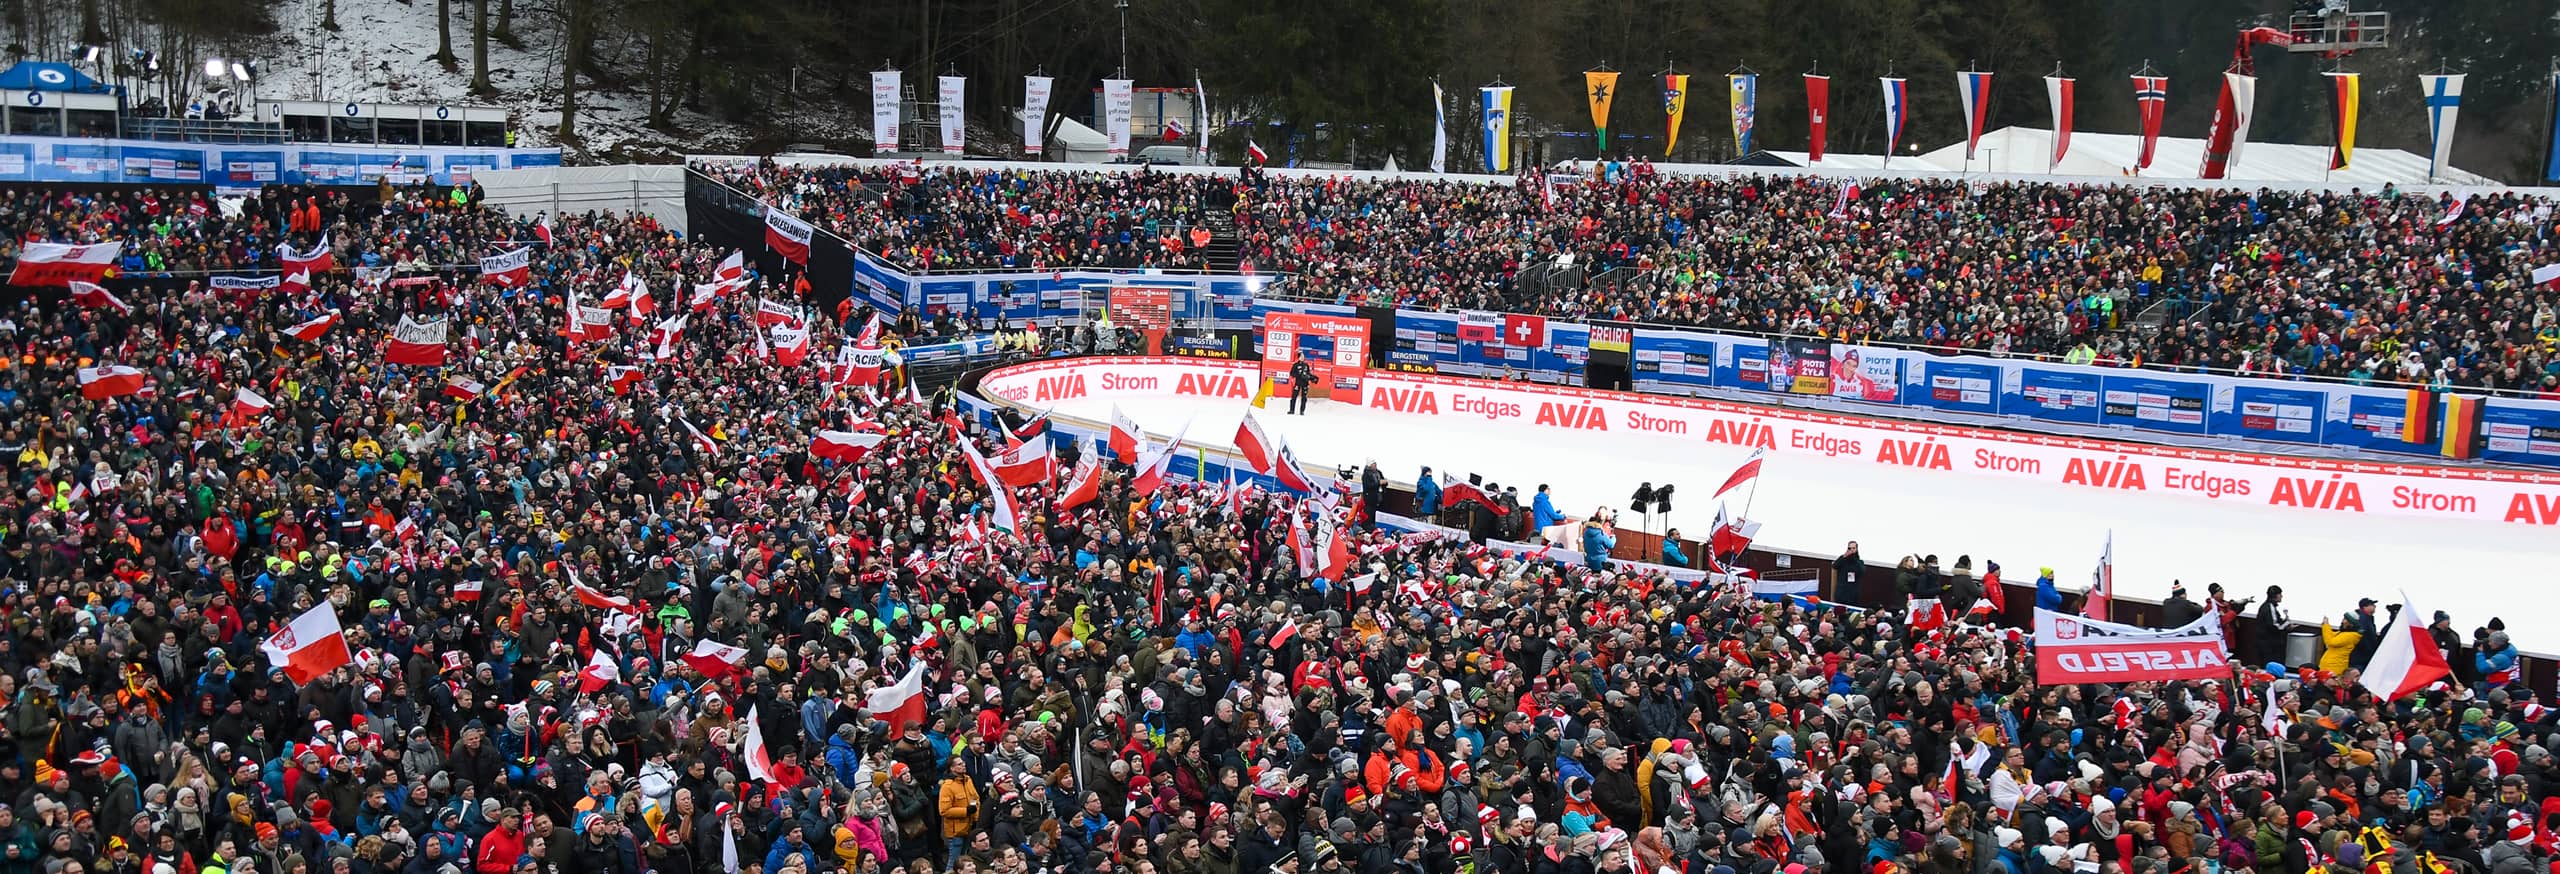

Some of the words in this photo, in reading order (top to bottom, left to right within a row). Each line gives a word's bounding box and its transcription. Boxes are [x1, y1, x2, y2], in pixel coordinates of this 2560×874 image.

[1590, 326, 1628, 344] ERFURT
[1802, 360, 1825, 369] PIOTR
[1865, 356, 1891, 365] PIOTR
[1867, 365, 1890, 375] ŻYŁA
[1102, 373, 1157, 390] Strom
[1453, 394, 1521, 419] Erdgas
[1628, 411, 1686, 434] Strom
[1792, 429, 1861, 456] Erdgas
[1975, 449, 2040, 474] Strom
[2165, 467, 2250, 498] Erdgas
[2392, 486, 2476, 512] Strom
